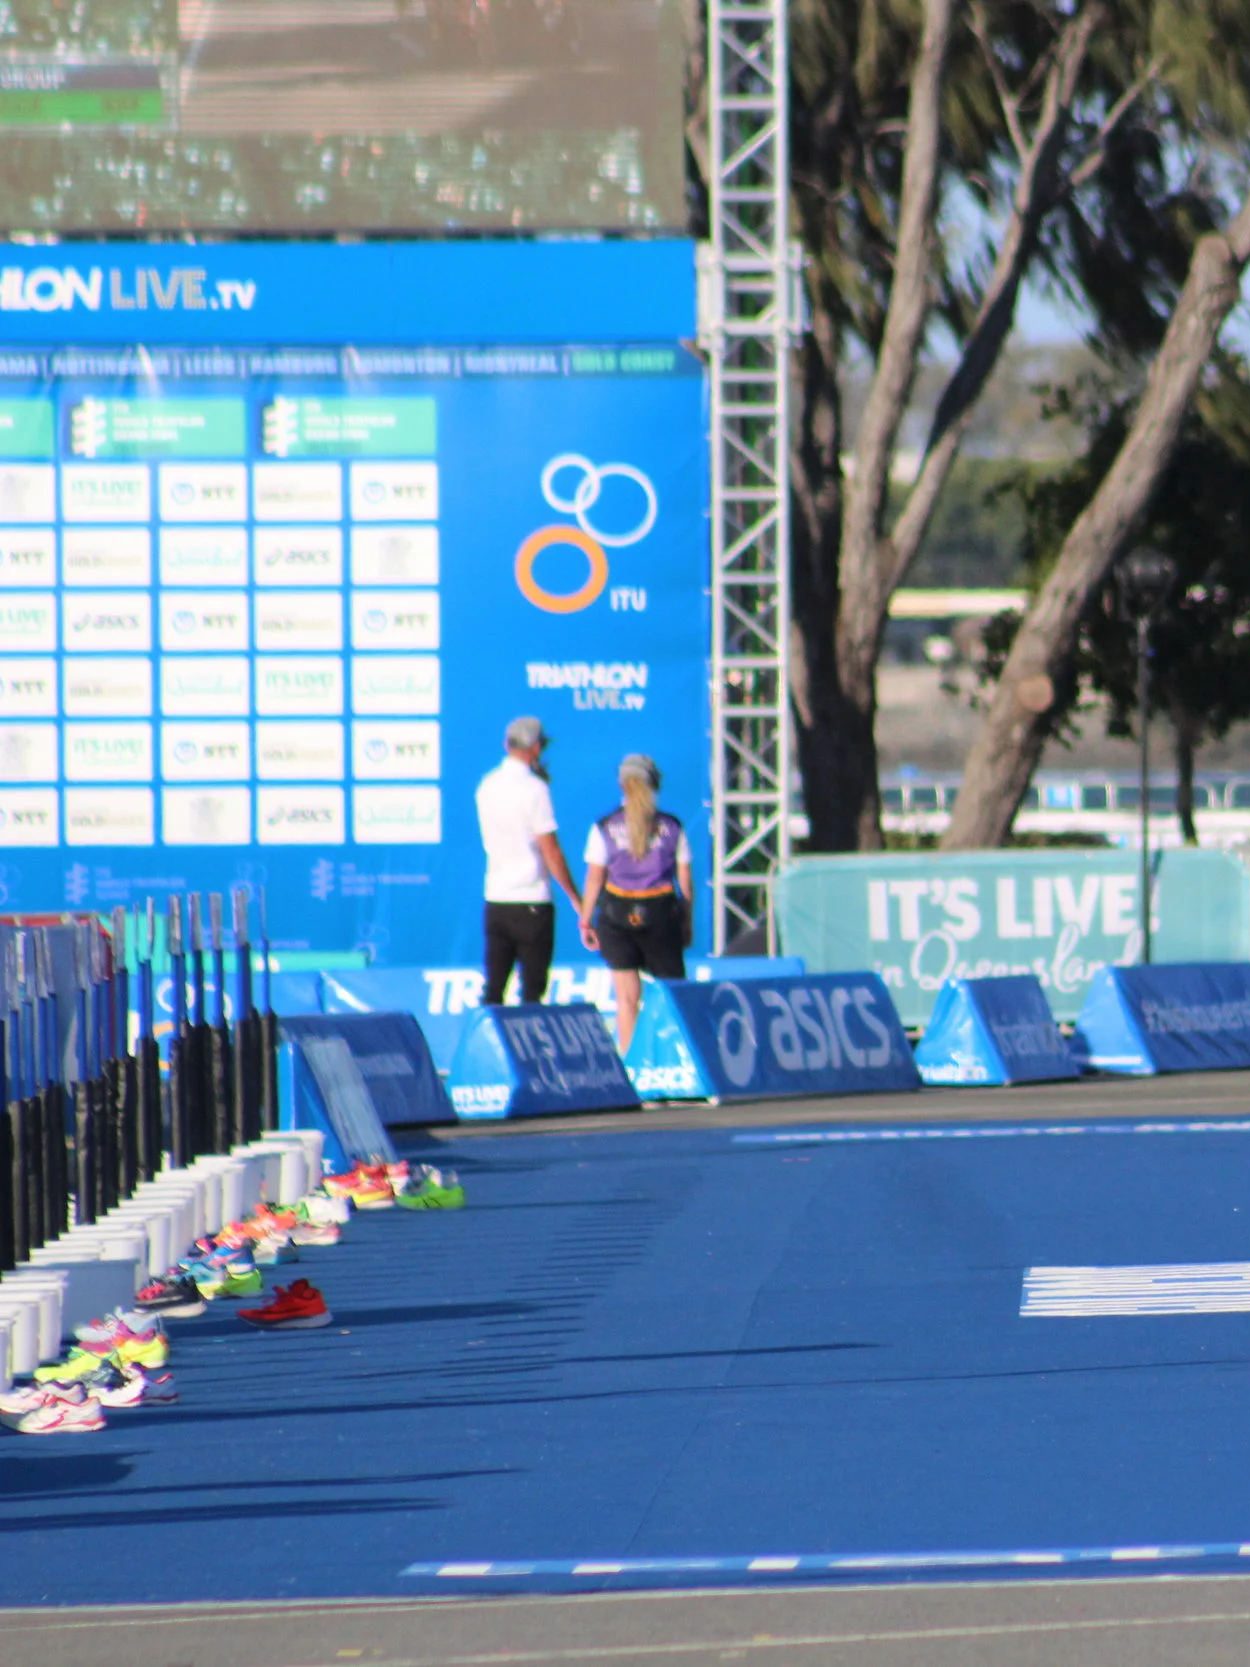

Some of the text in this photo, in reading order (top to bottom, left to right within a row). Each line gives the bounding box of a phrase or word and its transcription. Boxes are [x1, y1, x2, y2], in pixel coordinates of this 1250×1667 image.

[10, 552, 45, 565] NTT
[610, 588, 646, 611] ITU
[526, 663, 647, 689] TRIATHLON
[13, 811, 47, 825] NTT
[868, 876, 980, 942] IT'S
